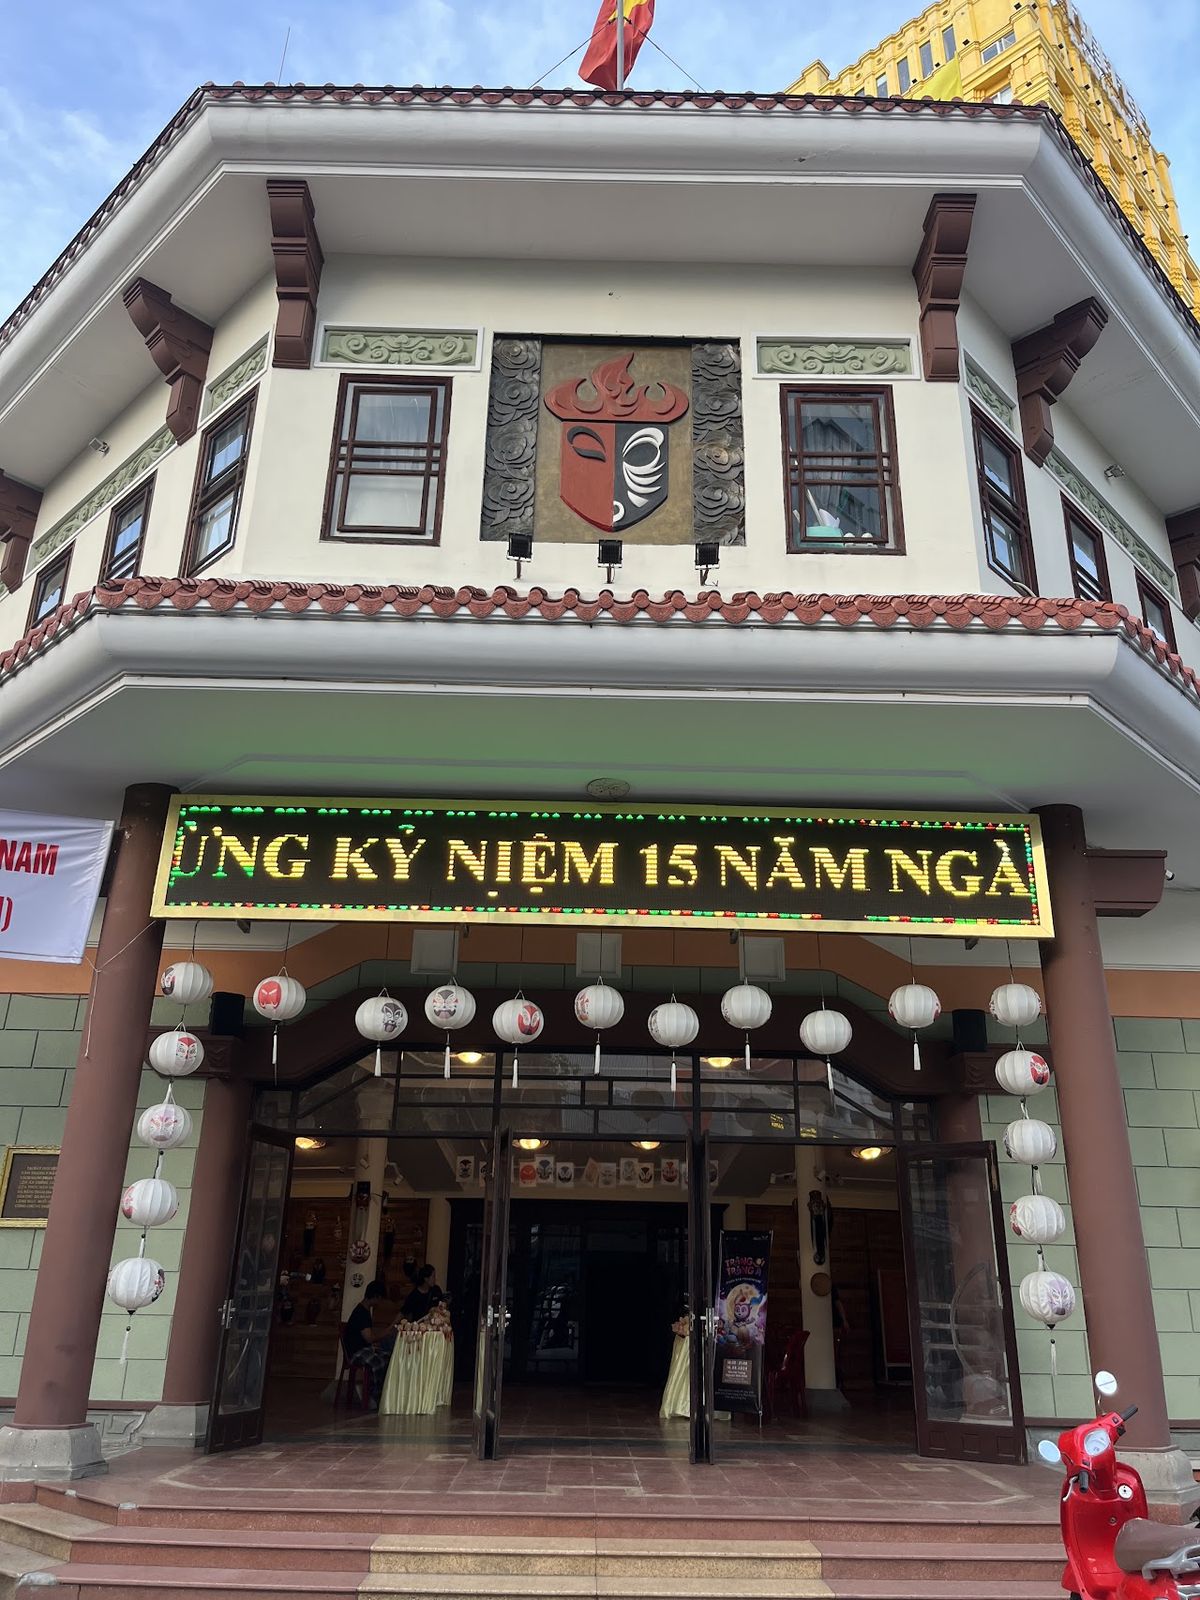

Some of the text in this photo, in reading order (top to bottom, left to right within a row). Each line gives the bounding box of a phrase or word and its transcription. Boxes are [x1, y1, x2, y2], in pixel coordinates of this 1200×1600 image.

[0, 839, 60, 876] NAM
[446, 832, 619, 897] NIỆM
[639, 842, 699, 886] 15
[714, 836, 870, 892] NĂM
[883, 838, 1032, 897] NGÀ
